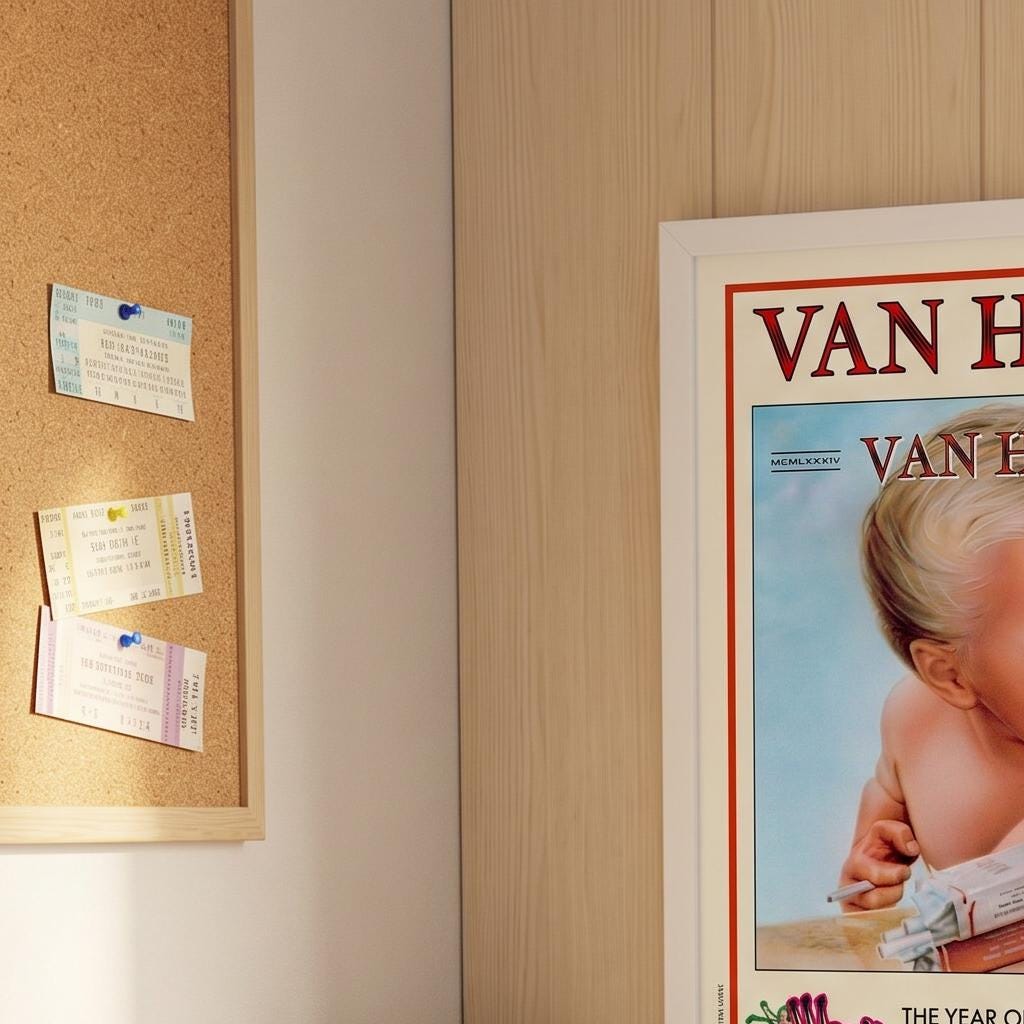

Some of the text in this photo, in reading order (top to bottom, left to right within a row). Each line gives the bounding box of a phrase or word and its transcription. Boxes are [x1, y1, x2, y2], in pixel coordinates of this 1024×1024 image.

[753, 299, 945, 382] VAN
[770, 455, 841, 467] MCMLXXXIV
[860, 432, 982, 484] VAN
